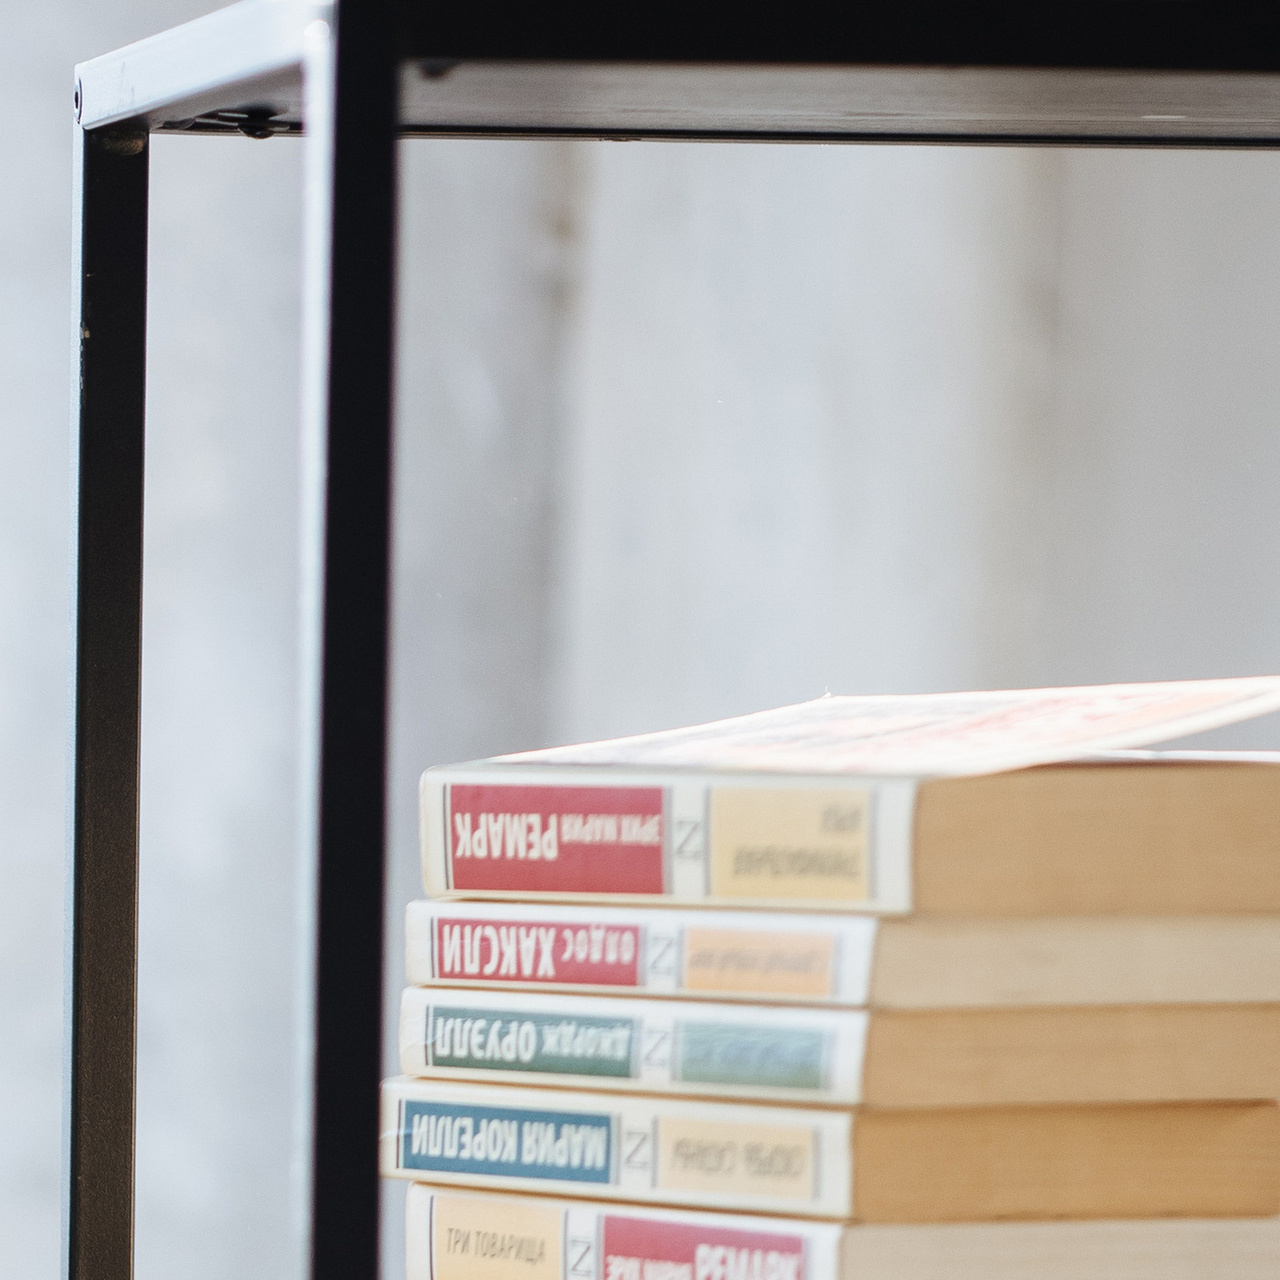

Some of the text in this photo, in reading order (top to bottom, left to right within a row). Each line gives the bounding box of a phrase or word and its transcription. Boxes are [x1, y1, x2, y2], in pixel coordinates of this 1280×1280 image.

[454, 811, 559, 861] РЕМАРК
[442, 923, 556, 978] ХАКСЛИ
[561, 923, 636, 964] ОЛДОС
[435, 1016, 631, 1063] ДЖОРДЖ ОРУЭЛЛ
[411, 1113, 608, 1171] МАРИЯ КОРЕЛЛИ
[447, 1227, 546, 1265] ТРИ ТОВАРИЩА
